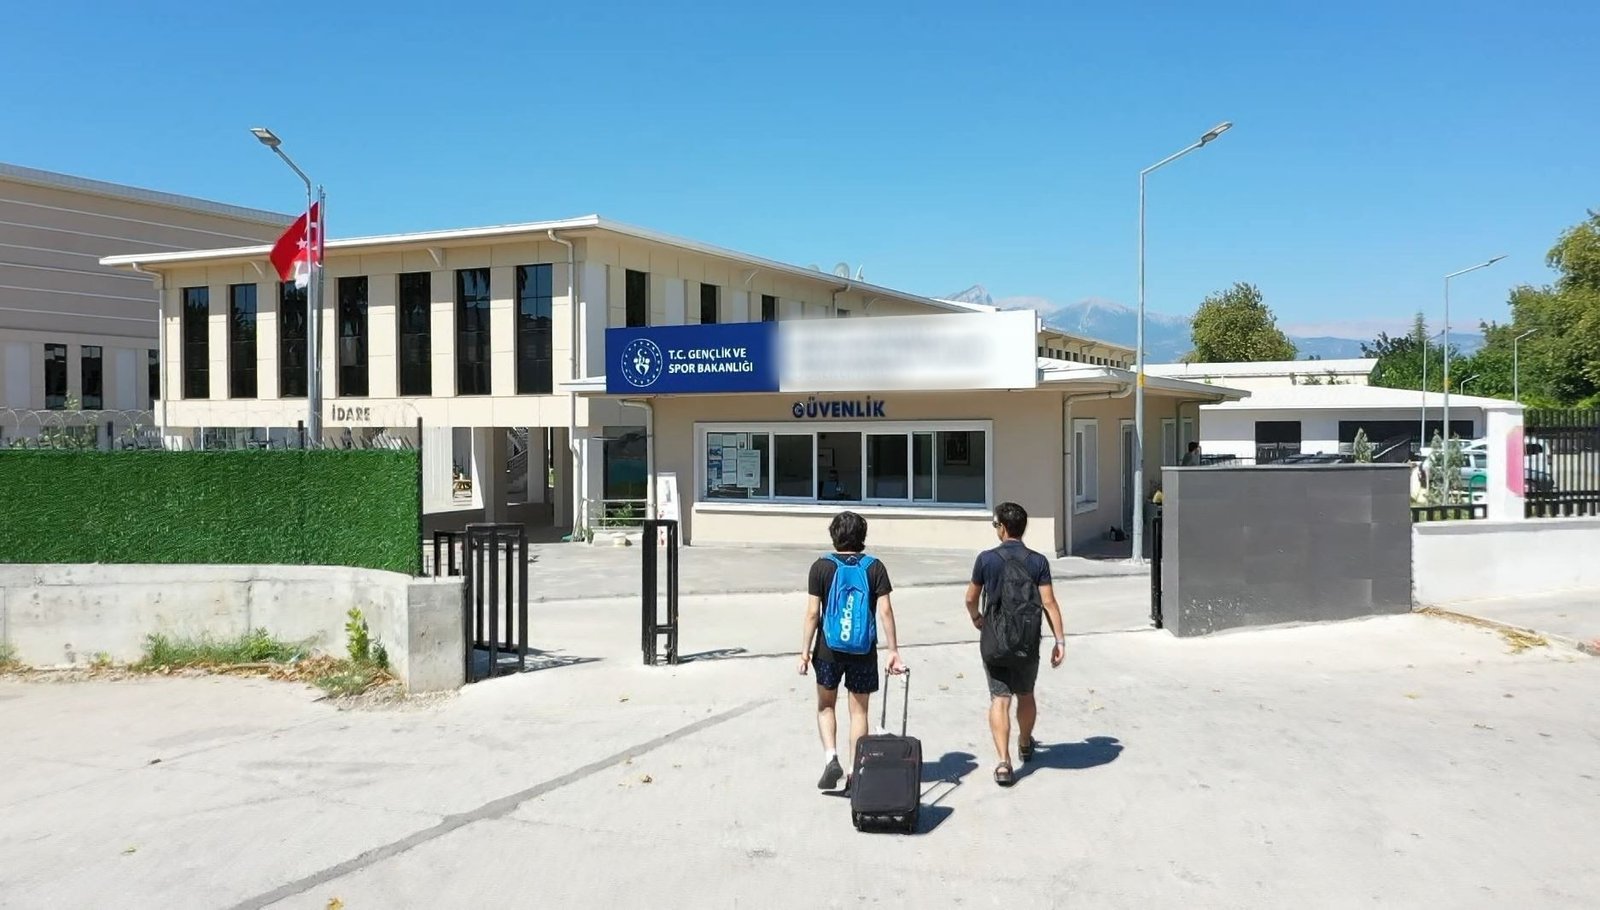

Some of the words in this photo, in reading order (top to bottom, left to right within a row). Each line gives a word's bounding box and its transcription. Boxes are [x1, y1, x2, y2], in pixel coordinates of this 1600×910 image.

[668, 350, 687, 360] T.C.
[688, 346, 731, 361] GENÇLİK
[732, 347, 747, 358] VE
[668, 363, 695, 374] SPOR
[697, 360, 753, 373] BAKANLIĞI
[332, 403, 370, 421] İDARE
[792, 395, 885, 418] GÜVENLİK
